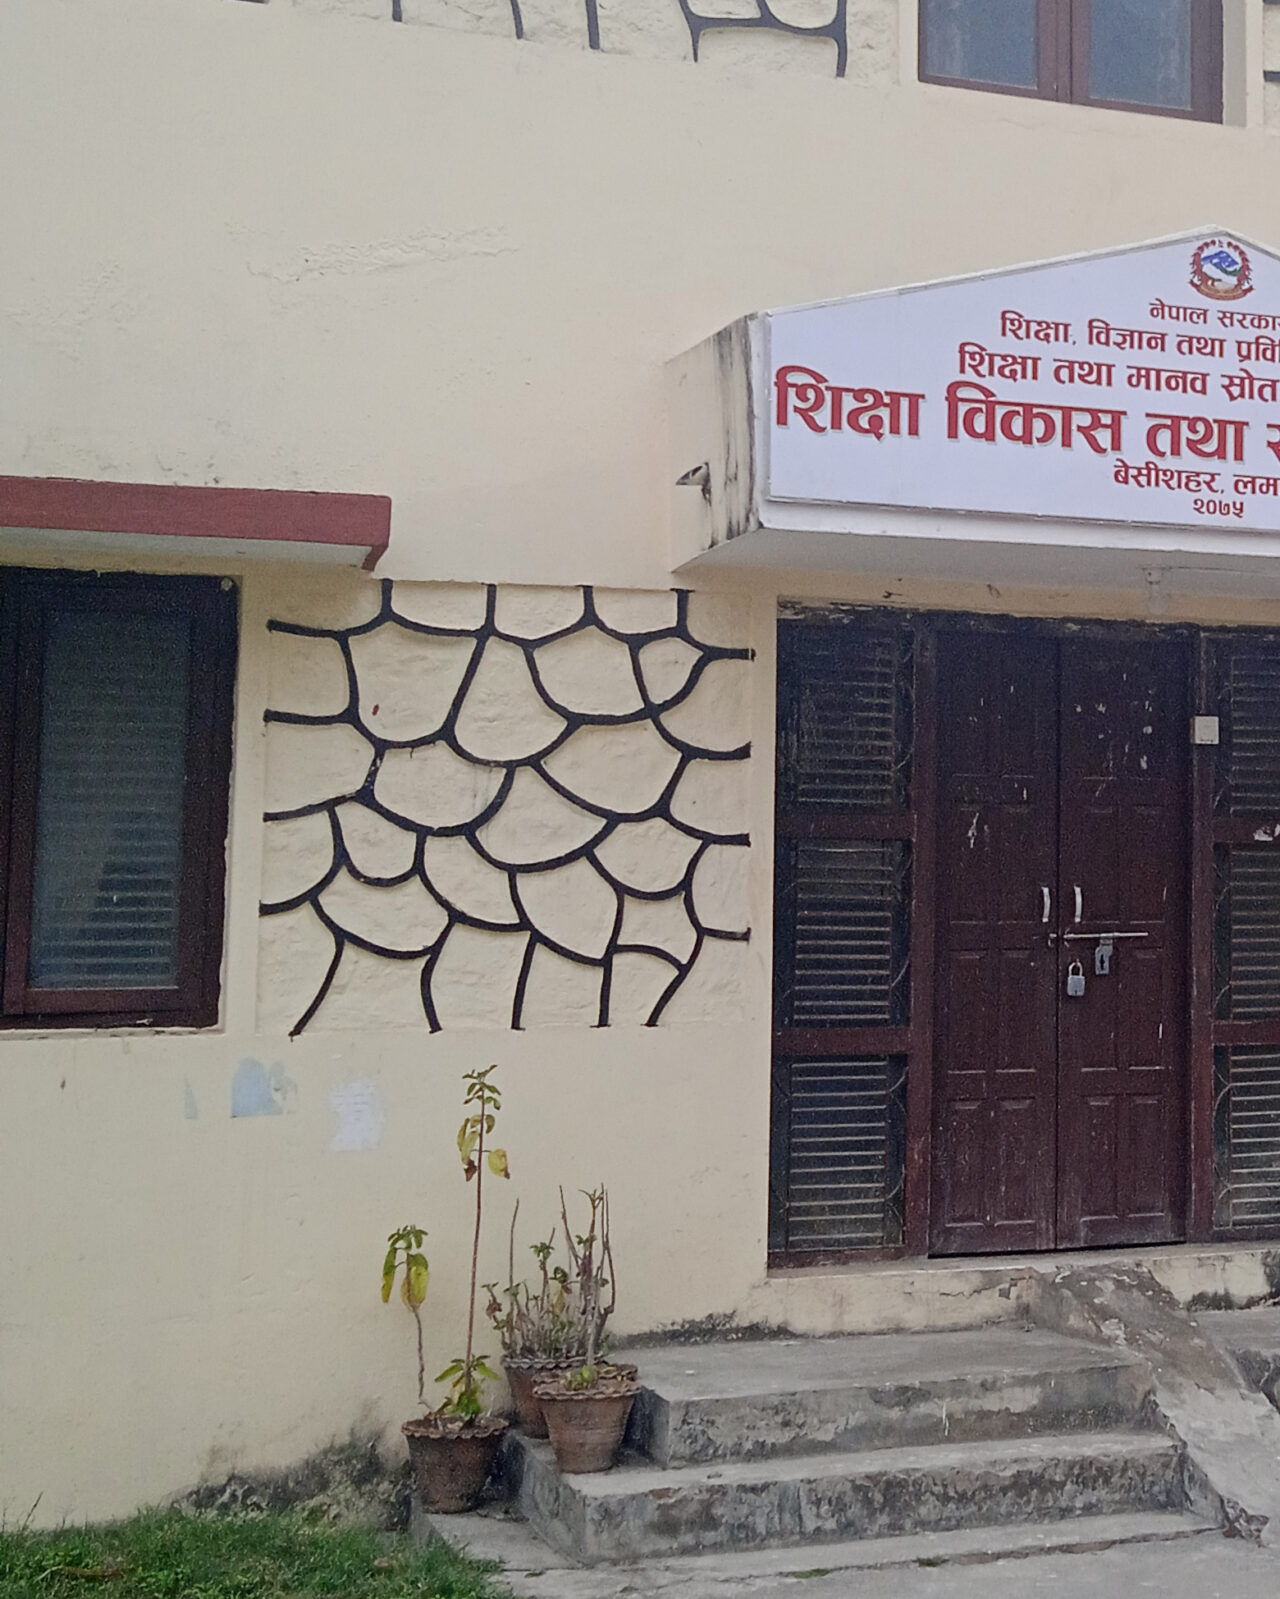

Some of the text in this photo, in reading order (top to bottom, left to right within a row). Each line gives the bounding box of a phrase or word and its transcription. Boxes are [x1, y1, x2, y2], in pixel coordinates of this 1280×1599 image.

[1149, 298, 1209, 324] नेपाल
[1087, 318, 1168, 352] विज्ञान
[1176, 334, 1226, 358] तथा
[958, 341, 1041, 383] शिक्षा
[1053, 358, 1115, 388] तथा
[1127, 365, 1210, 396] मानव
[1221, 368, 1280, 403] स्रोत
[774, 365, 926, 441] शिक्षा
[945, 380, 1128, 454] विकास
[1145, 412, 1250, 461] तथा
[1193, 498, 1245, 518] २०७५
